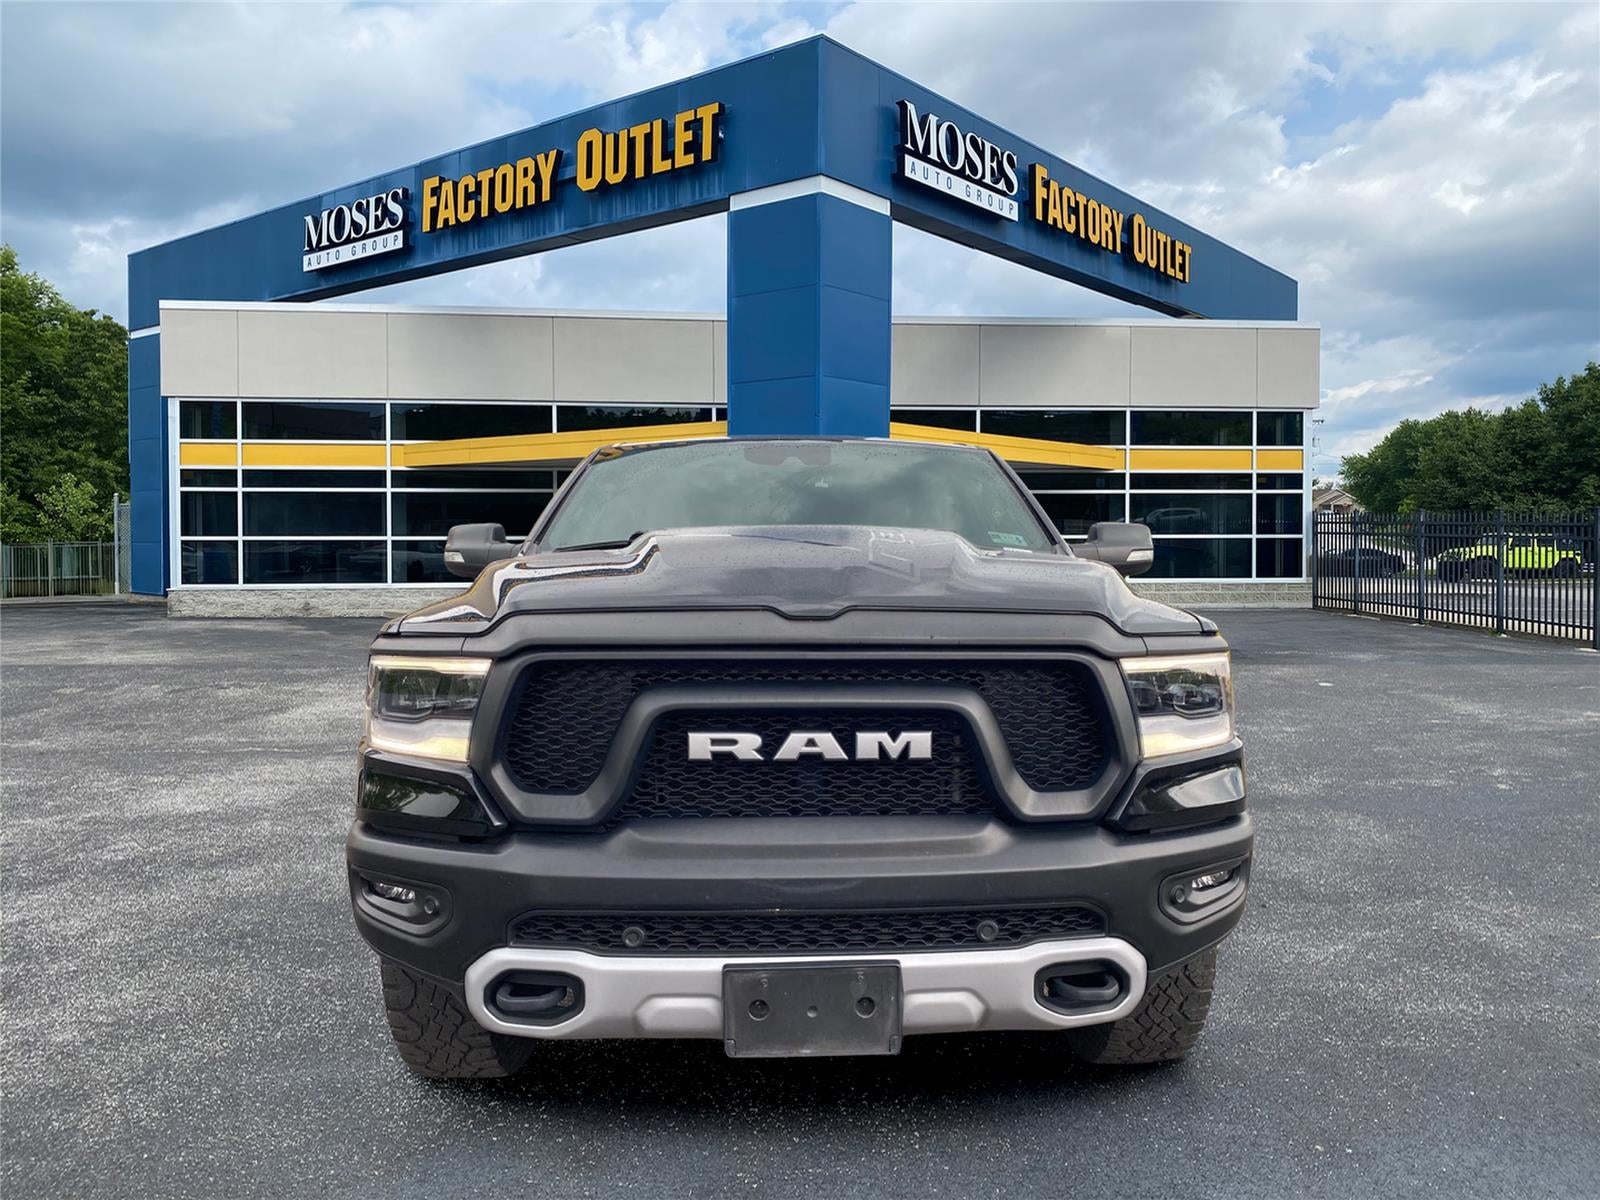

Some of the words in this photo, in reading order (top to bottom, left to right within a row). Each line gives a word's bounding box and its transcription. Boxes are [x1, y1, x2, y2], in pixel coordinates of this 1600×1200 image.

[422, 149, 558, 232] FACTORY
[576, 102, 719, 191] OUTLET
[904, 100, 1018, 196] MOSES
[303, 187, 404, 251] MOSES
[910, 161, 953, 190] AUTO
[965, 184, 1014, 215] GROUP
[306, 248, 341, 268] AUTO
[350, 234, 400, 257] GROUP
[1035, 163, 1124, 254] FACTORY
[1132, 213, 1192, 283] OUTLET
[688, 731, 932, 760] RAM
